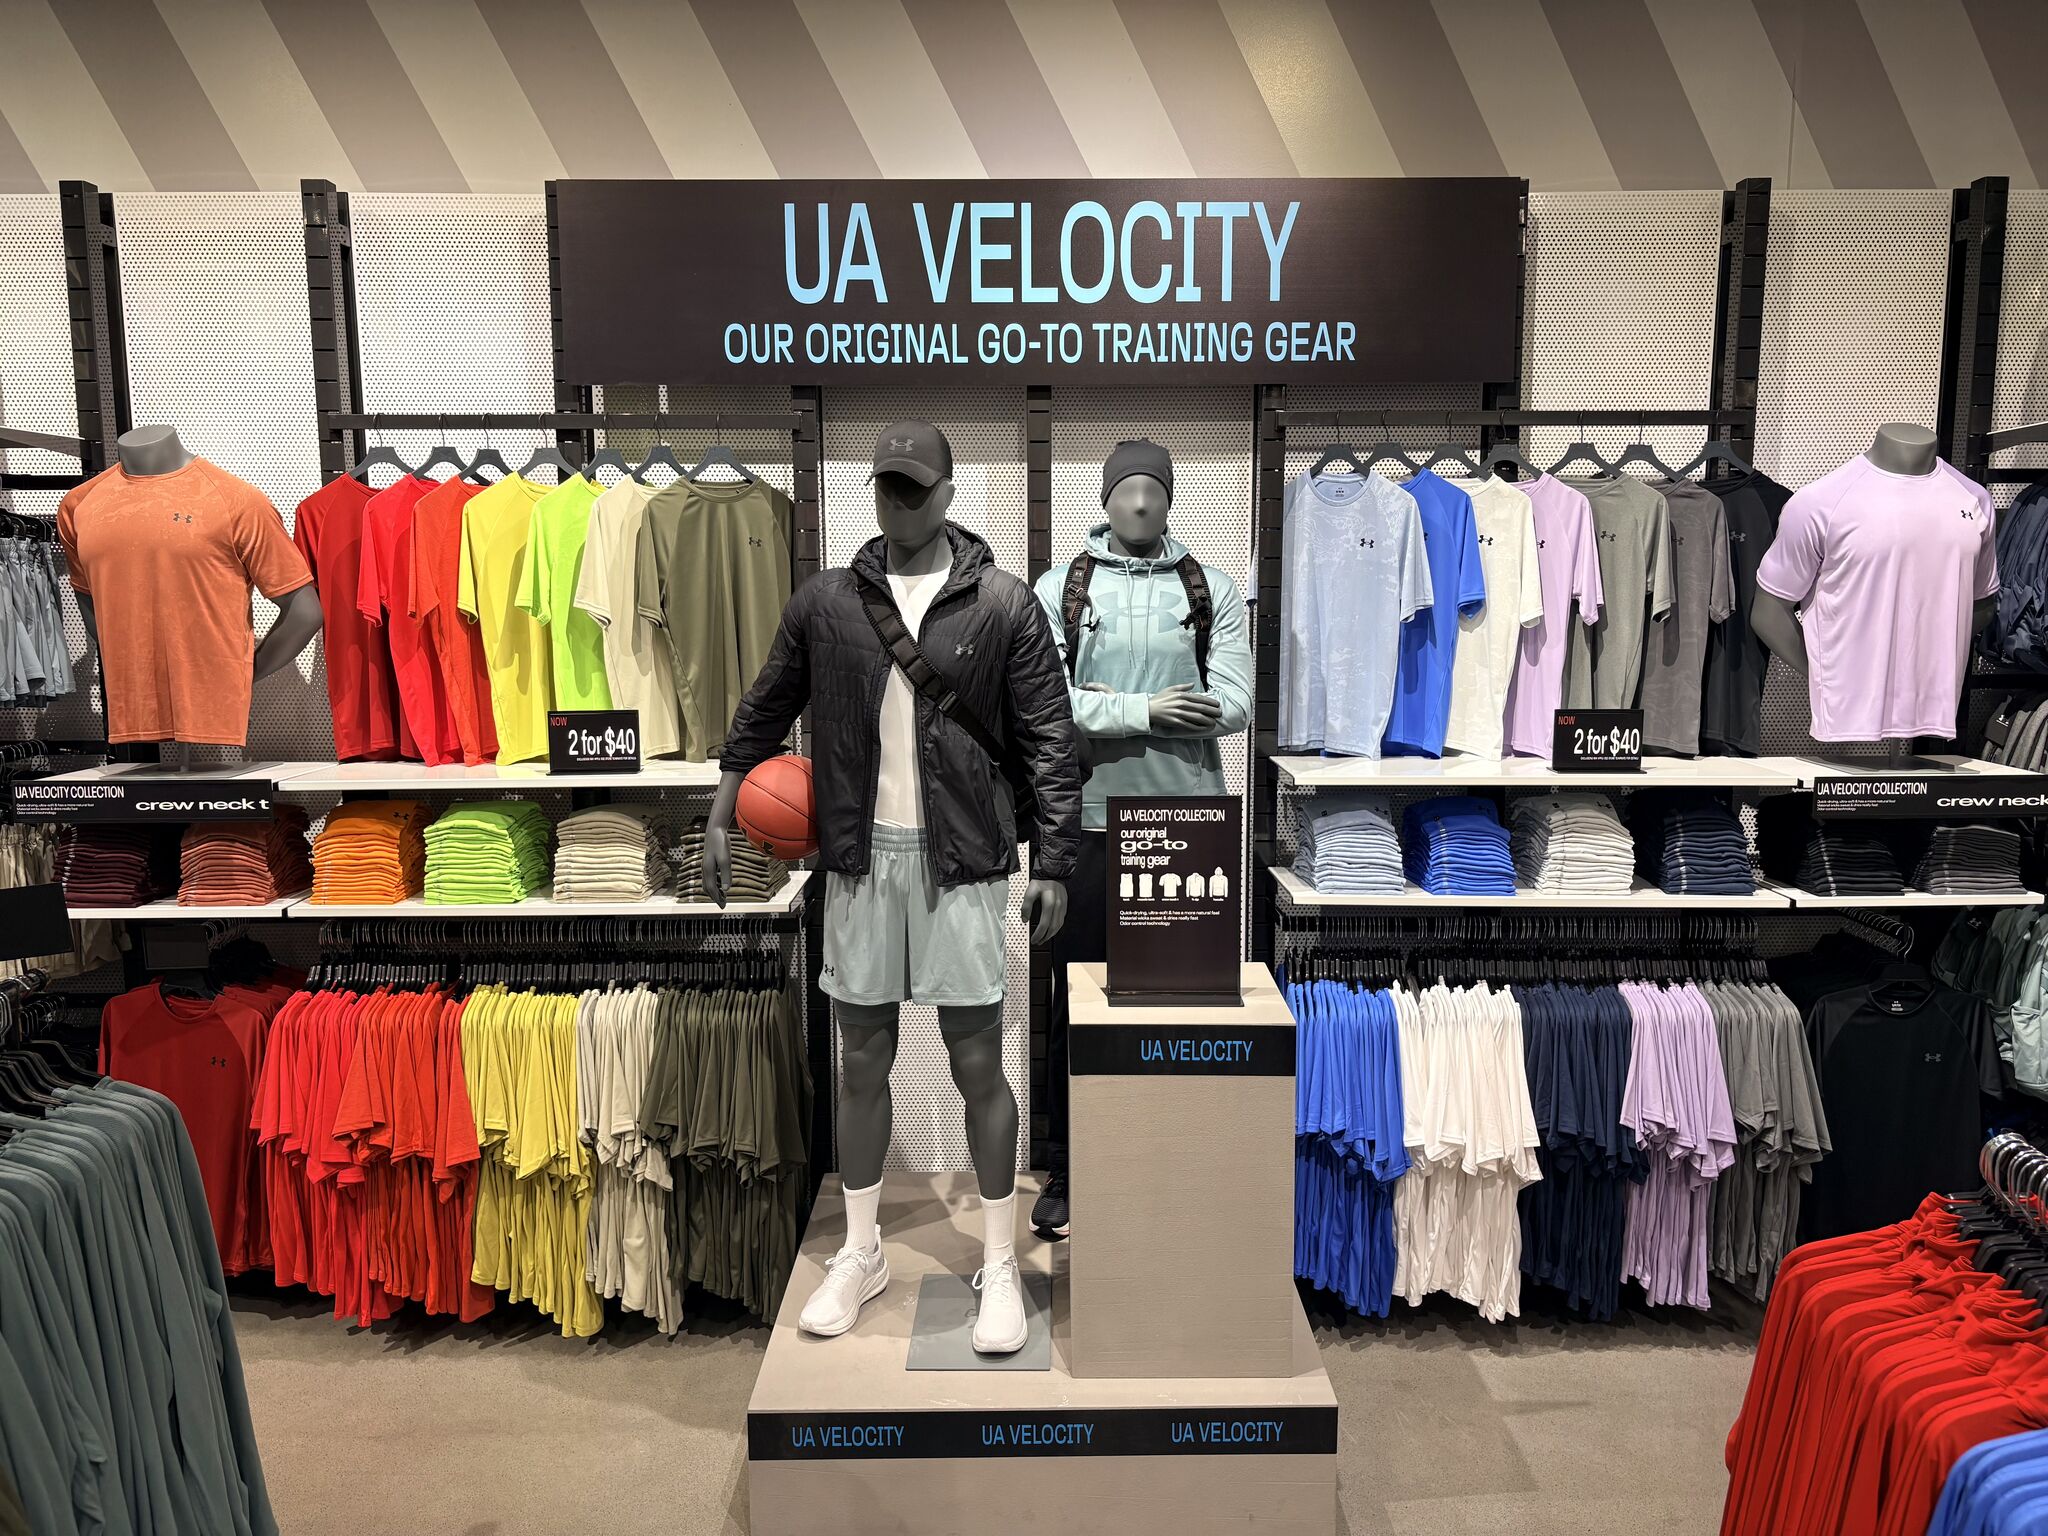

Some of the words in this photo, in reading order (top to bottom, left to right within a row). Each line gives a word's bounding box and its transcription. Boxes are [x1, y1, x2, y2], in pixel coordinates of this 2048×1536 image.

[783, 202, 888, 304] UA
[912, 200, 1300, 303] VELOCITY
[724, 323, 794, 364] OUR
[804, 323, 968, 364] ORIGINAL
[977, 323, 1083, 364] GO-TO
[1099, 322, 1253, 362] TRAINING
[1265, 321, 1356, 361] GEAR
[550, 716, 568, 727] NOW
[1558, 715, 1576, 726] NOW
[568, 729, 579, 756] 2
[581, 729, 602, 756] for
[604, 726, 636, 758] $40
[1573, 728, 1584, 755] 2
[1586, 728, 1608, 755] for
[1609, 725, 1640, 757] $40
[15, 786, 29, 799] UA
[28, 786, 70, 799] VELOCITY
[70, 785, 125, 799] COLLECTION
[1816, 782, 1830, 796] UA
[1830, 782, 1872, 795] VELOCITY
[1872, 782, 1928, 795] COLLECTION
[135, 801, 194, 811] crew
[198, 798, 255, 810] neck
[258, 799, 270, 810] t
[1936, 797, 1995, 807] crew
[1120, 809, 1133, 821] UA
[1133, 809, 1173, 822] VELOCITY
[1173, 809, 1225, 822] COLLECTION
[1120, 829, 1136, 839] our
[1136, 827, 1167, 841] original
[1120, 839, 1188, 854] go-to
[1120, 853, 1146, 869] training
[1146, 855, 1171, 869] gear
[1141, 1040, 1164, 1060] UA
[1168, 1040, 1253, 1061] VELOCITY
[792, 1427, 815, 1447] UA
[819, 1426, 904, 1447] VELOCITY
[982, 1425, 1004, 1445] UA
[1008, 1424, 1094, 1445] VELOCITY
[1171, 1422, 1194, 1443] UA
[1198, 1422, 1283, 1442] VELOCITY
